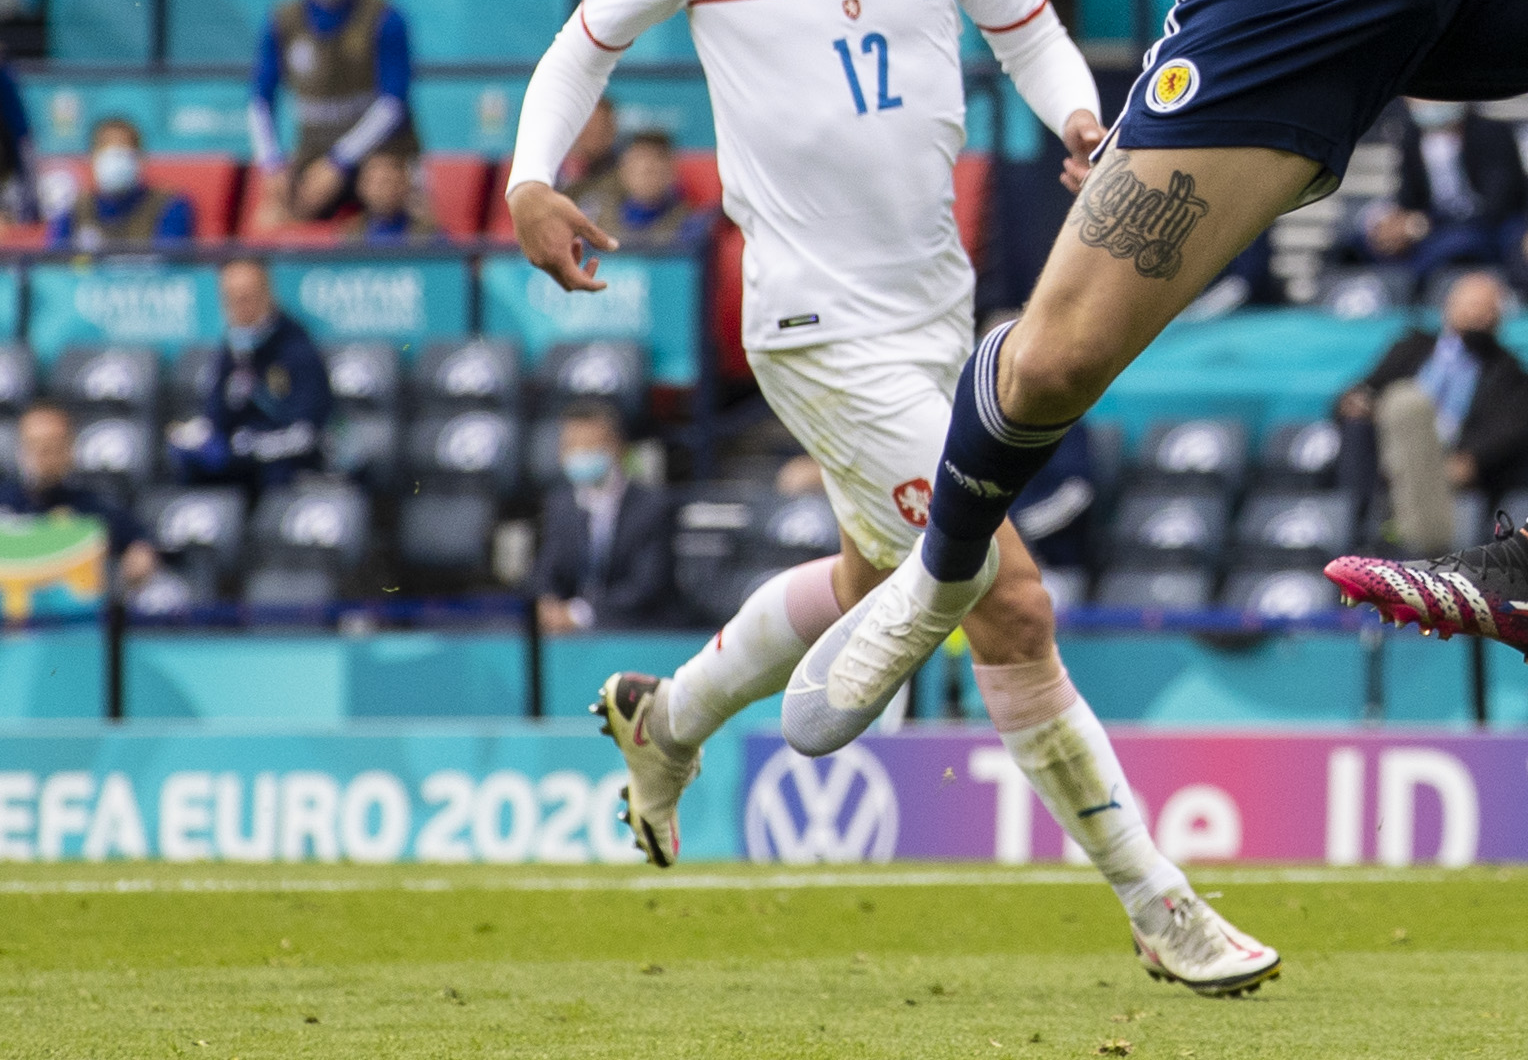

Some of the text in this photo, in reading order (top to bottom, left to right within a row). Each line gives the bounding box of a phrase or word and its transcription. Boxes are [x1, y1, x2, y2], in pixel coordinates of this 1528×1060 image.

[832, 32, 904, 116] 12
[158, 770, 411, 862] EURO
[968, 745, 1243, 865] Te
[1327, 745, 1480, 867] ID
